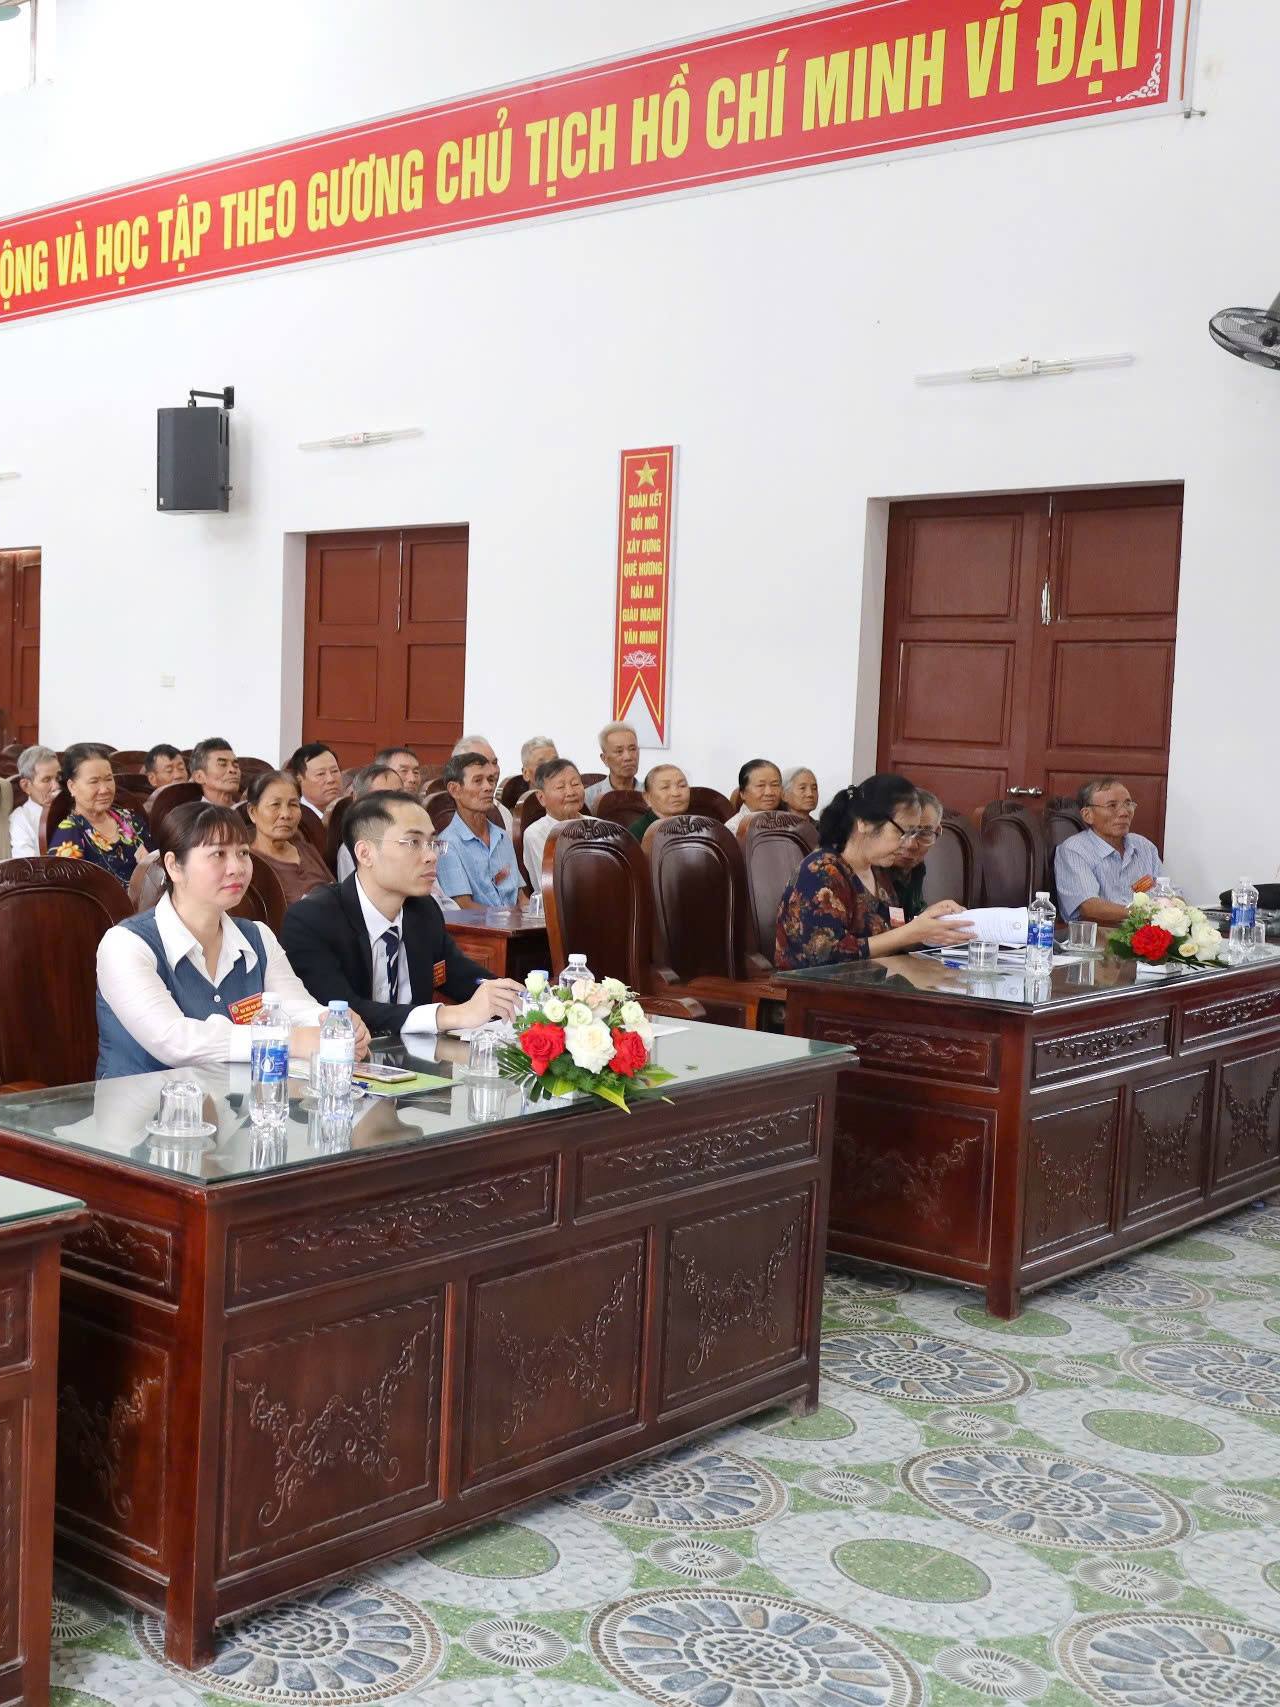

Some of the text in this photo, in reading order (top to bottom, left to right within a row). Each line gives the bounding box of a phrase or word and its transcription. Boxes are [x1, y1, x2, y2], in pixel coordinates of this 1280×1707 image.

[56, 220, 88, 286] VÀ
[96, 215, 149, 285] HỌC
[157, 194, 211, 272] TẬP
[220, 179, 296, 250] THEO
[307, 149, 424, 232] GƯƠNG
[436, 107, 513, 205] CHỦ
[525, 104, 617, 198] TỊCH
[631, 63, 691, 165] HỒ
[706, 48, 789, 150] CHÍ
[802, 28, 947, 132] MINH
[965, 0, 1022, 99] VĨ
[1036, 0, 1142, 95] ĐẠI
[649, 489, 662, 507] KẾT
[623, 560, 638, 577] QUÊ
[643, 584, 654, 598] AN
[639, 607, 661, 624] MẠNH
[623, 628, 658, 644] VĂN MINH
